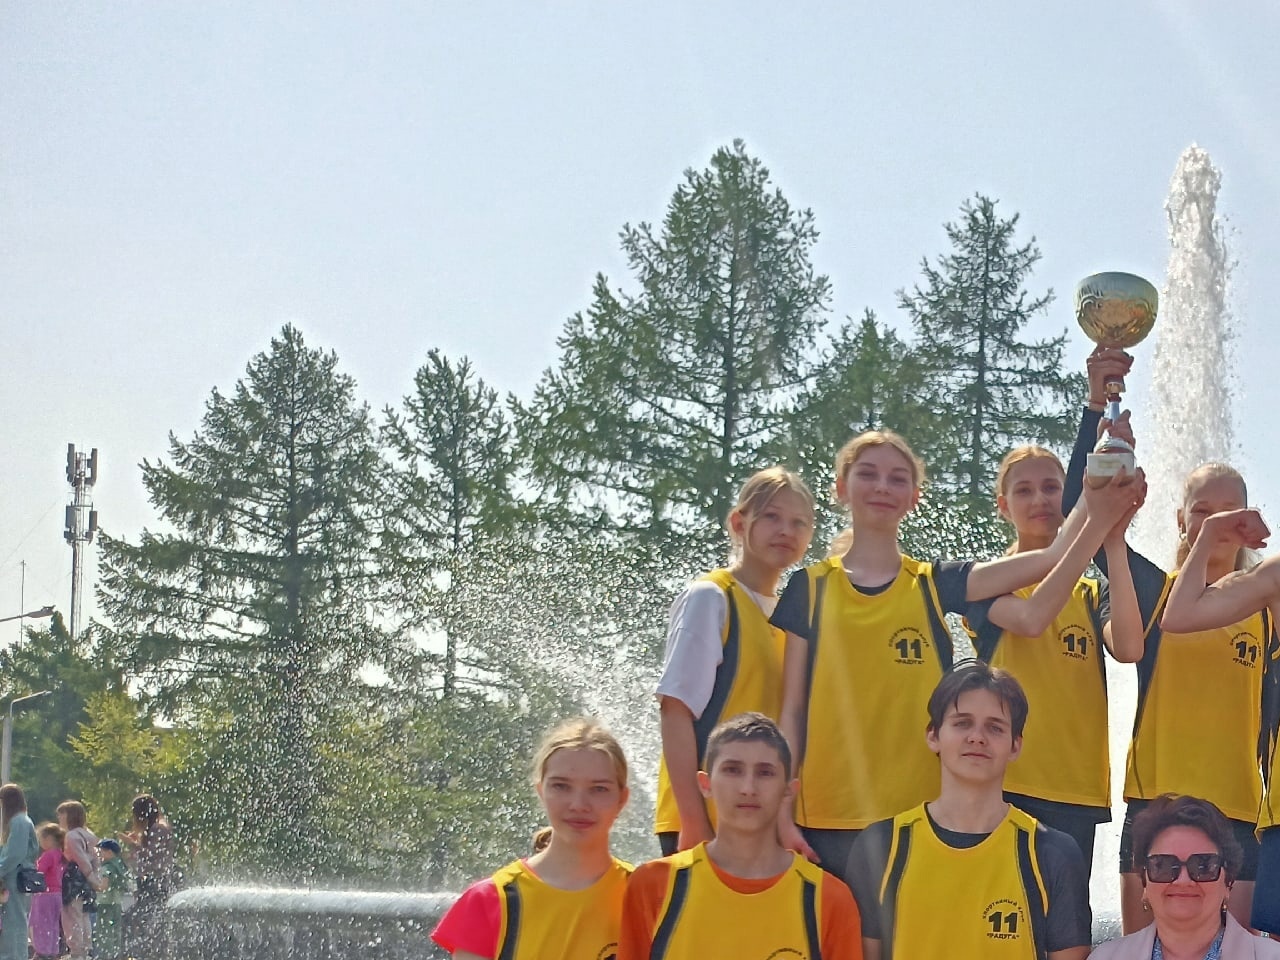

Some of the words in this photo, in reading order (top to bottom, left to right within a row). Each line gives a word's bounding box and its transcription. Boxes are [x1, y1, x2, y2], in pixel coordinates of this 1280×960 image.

[895, 638, 922, 659] 11
[1063, 633, 1087, 656] 11
[1235, 641, 1257, 663] 11
[988, 911, 1018, 933] 11
